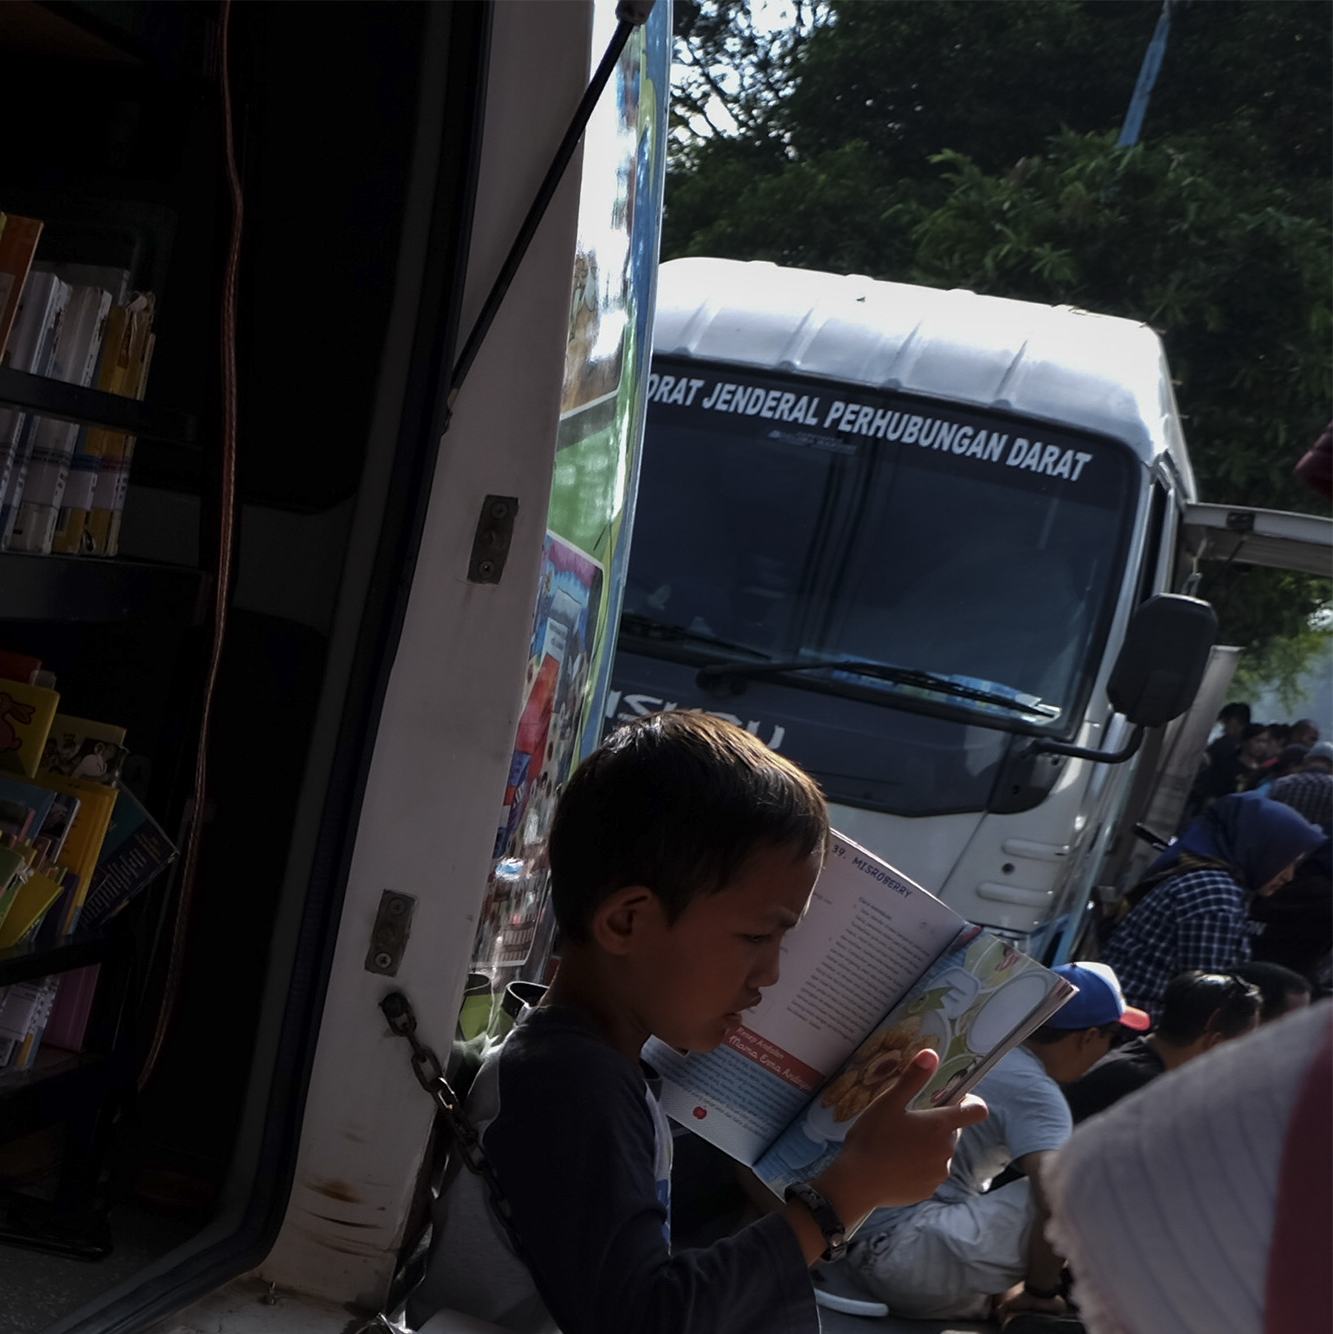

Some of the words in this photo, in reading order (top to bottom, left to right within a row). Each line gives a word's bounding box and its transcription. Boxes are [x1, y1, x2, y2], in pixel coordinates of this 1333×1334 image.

[702, 382, 819, 426] JENDERAL
[822, 401, 1009, 463] PERHUBUNGAN
[1006, 437, 1092, 482] DARAT
[831, 844, 847, 860] 39.
[852, 857, 913, 899] MISROBERRY
[728, 1035, 759, 1059] Mama
